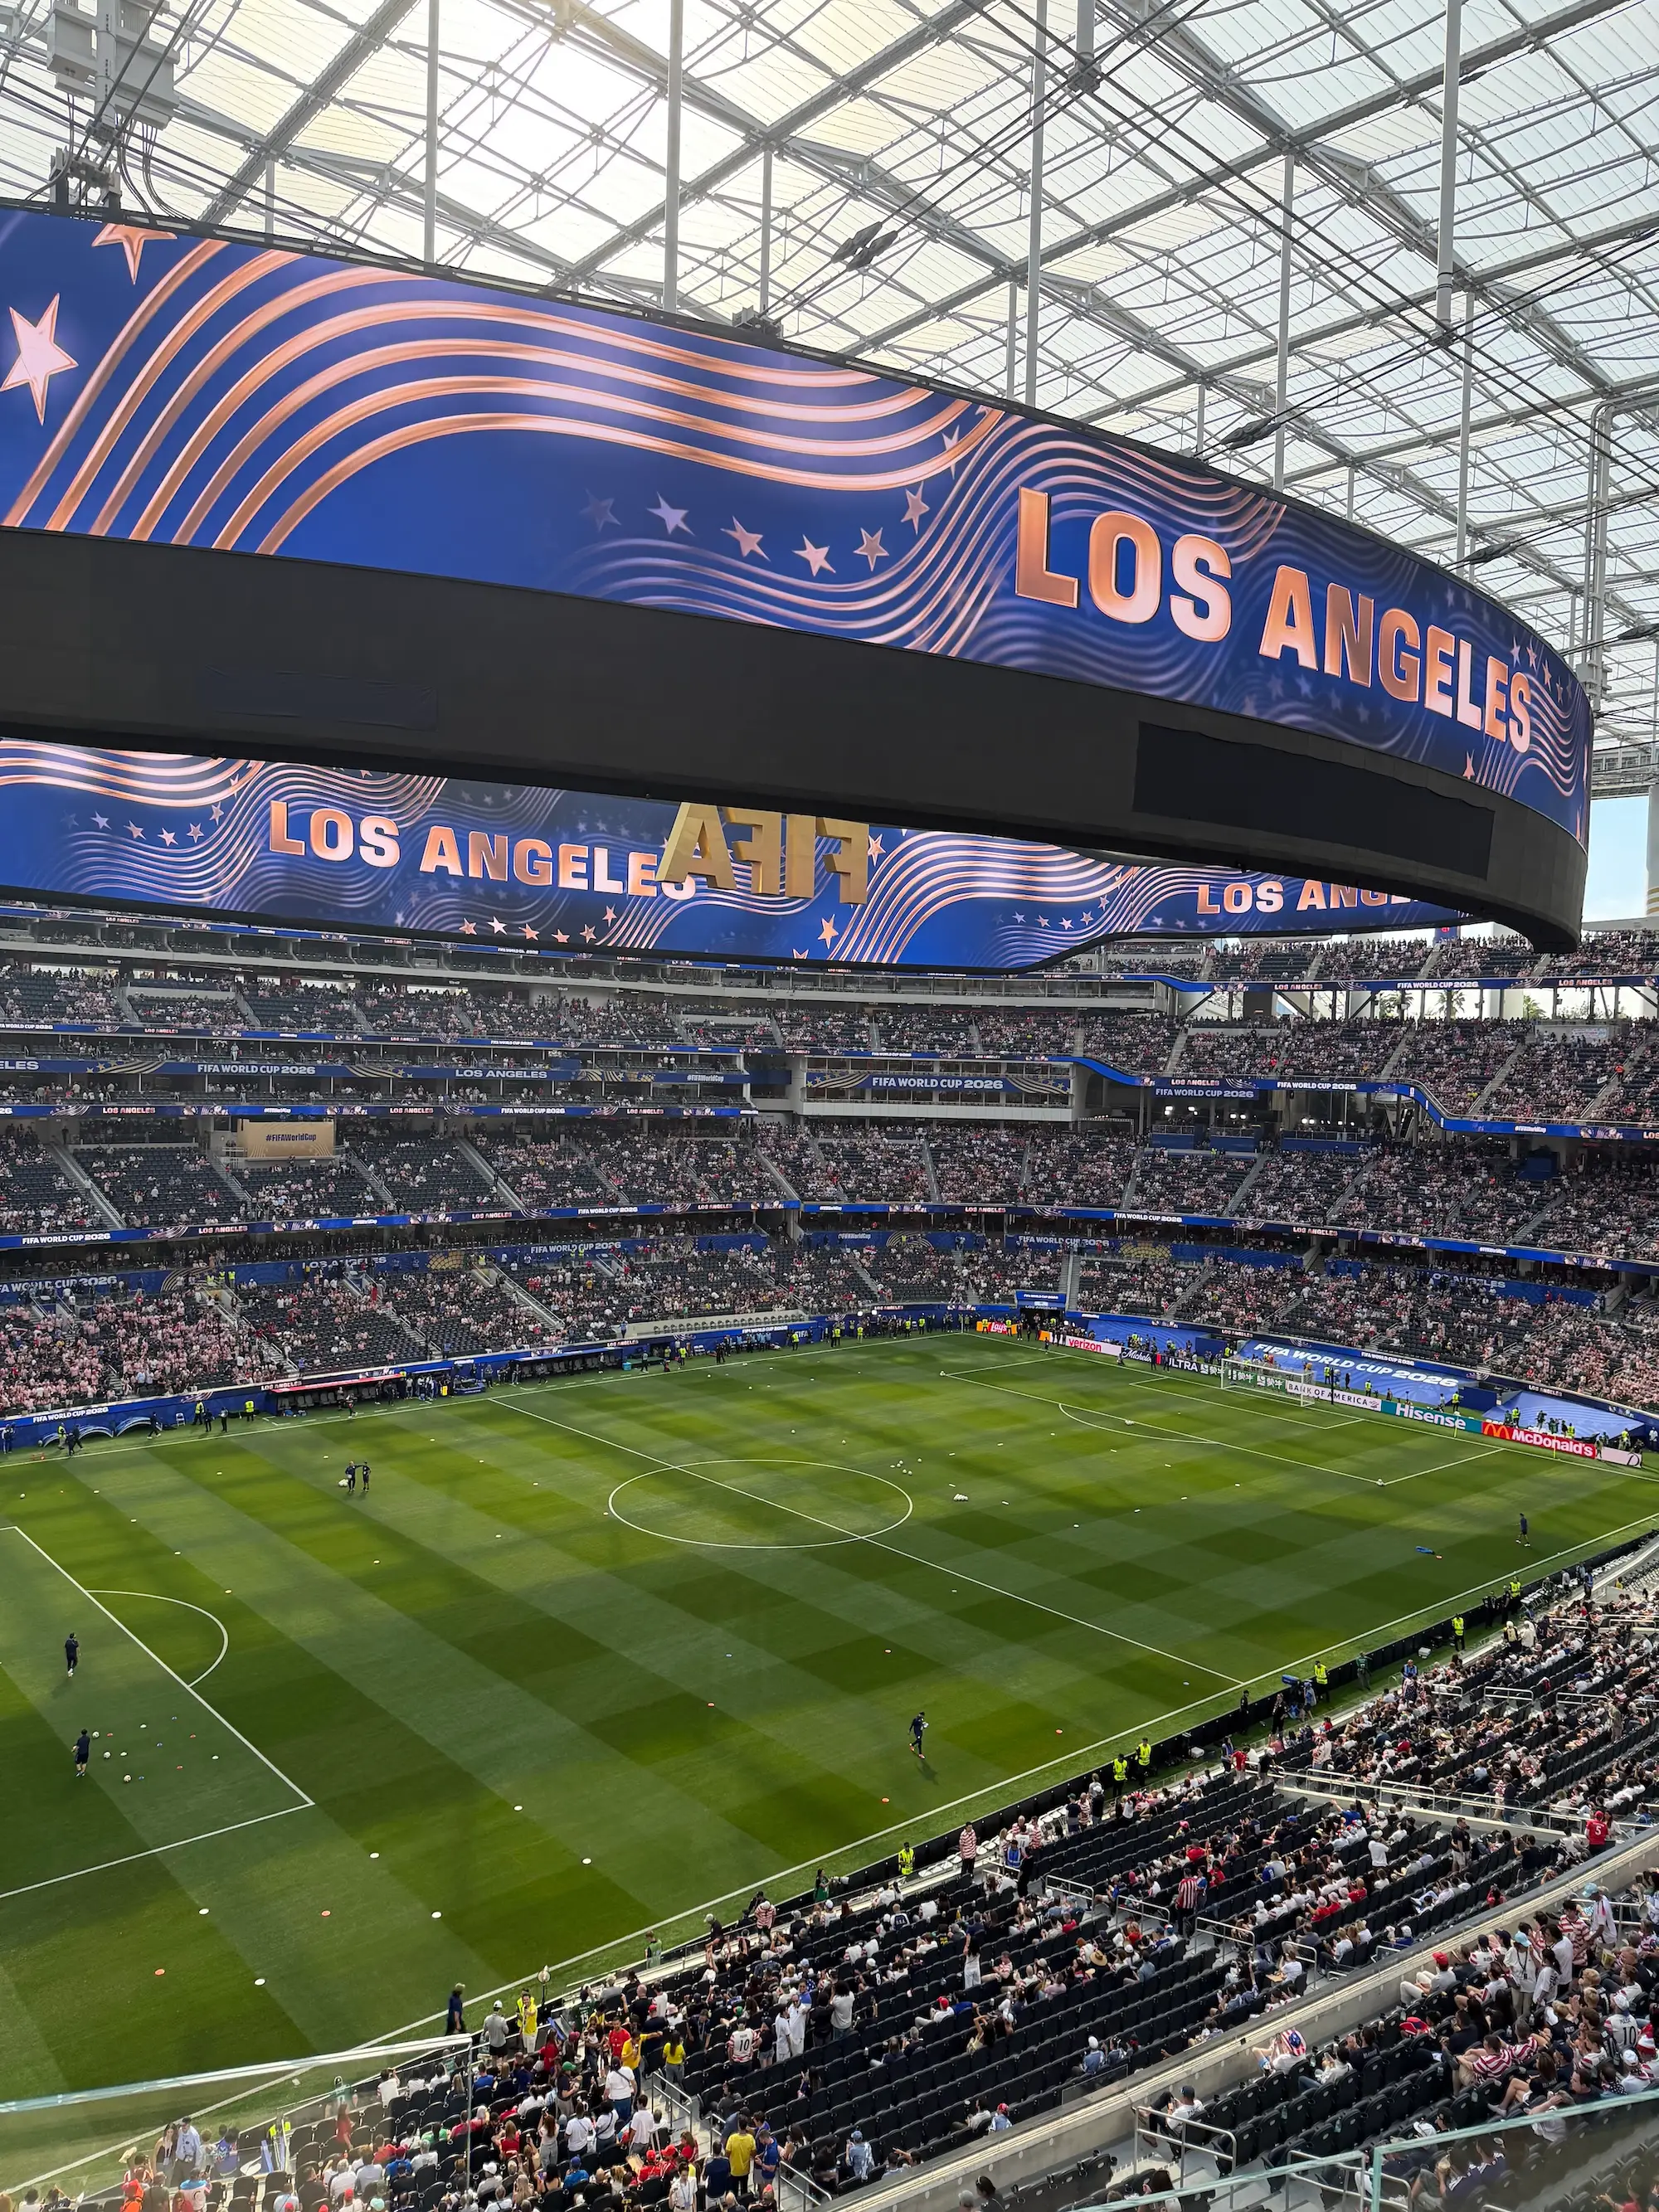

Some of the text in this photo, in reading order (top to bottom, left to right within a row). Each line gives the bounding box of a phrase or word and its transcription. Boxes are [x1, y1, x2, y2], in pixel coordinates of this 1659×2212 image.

[1014, 486, 1531, 752] LOS ANGELES
[270, 800, 401, 868] LOS
[1196, 881, 1283, 916] LOS
[197, 1064, 221, 1073] FIFA
[221, 1064, 259, 1073] WORLD
[280, 1066, 315, 1075] 2026
[455, 1069, 547, 1078] LOS ANGELES
[872, 1077, 1004, 1090] FIFA WORLD CUP 2026
[1223, 1090, 1254, 1098] 2026
[265, 1133, 317, 1142] #FIFAWorldCup
[1643, 1131, 1659, 1140] LOS
[40, 1235, 68, 1243] WORLD
[85, 1232, 111, 1241] 2026
[1307, 1228, 1338, 1237] ANGELES
[1036, 1236, 1064, 1244] WORLD
[531, 1241, 621, 1254] FIFA WORLD CUP 2026
[55, 1279, 77, 1289] CUP
[78, 1276, 118, 1286] 2026
[1068, 1339, 1102, 1352] verizon
[1121, 1349, 1151, 1363] Michelo
[1253, 1344, 1459, 1387] FIFA WORLD CUP 2026
[1288, 1383, 1368, 1406] BANK OF AMERICA
[48, 1412, 71, 1421] WORLD
[86, 1407, 109, 1415] 2026
[1395, 1402, 1467, 1430] Hisense
[1511, 1428, 1594, 1457] McDonald's
[1595, 1825, 1601, 1835] 5
[876, 1974, 881, 1986] 8
[1623, 2025, 1637, 2045] 10
[740, 2039, 750, 2052] 10
